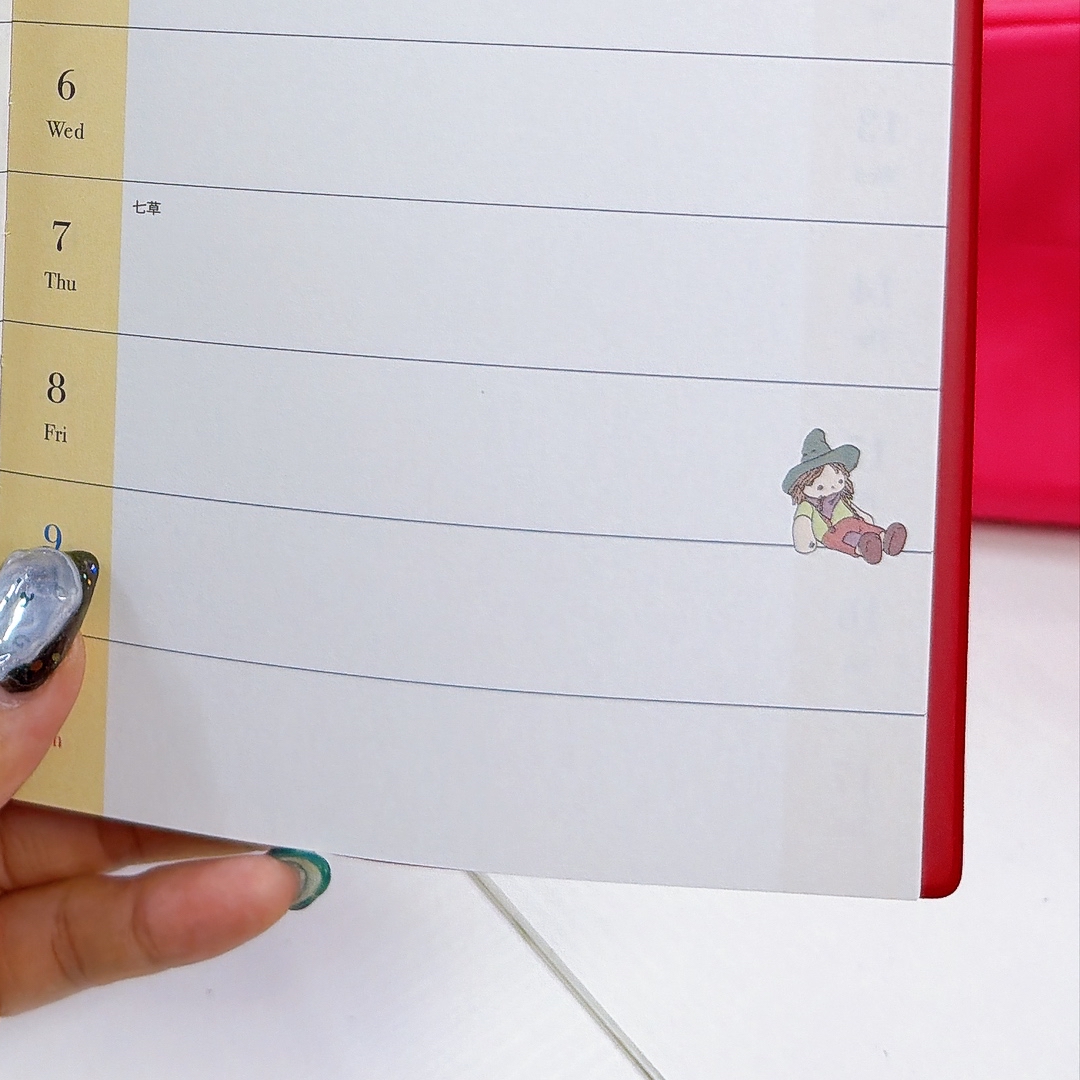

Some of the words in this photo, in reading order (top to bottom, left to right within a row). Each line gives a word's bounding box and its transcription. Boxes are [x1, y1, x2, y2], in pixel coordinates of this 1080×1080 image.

[58, 70, 75, 100] 6
[46, 120, 84, 139] Wed
[133, 200, 161, 215] 七草
[53, 221, 71, 251] 7
[44, 272, 76, 291] Thu
[48, 372, 66, 403] 8
[45, 423, 67, 443] Fri
